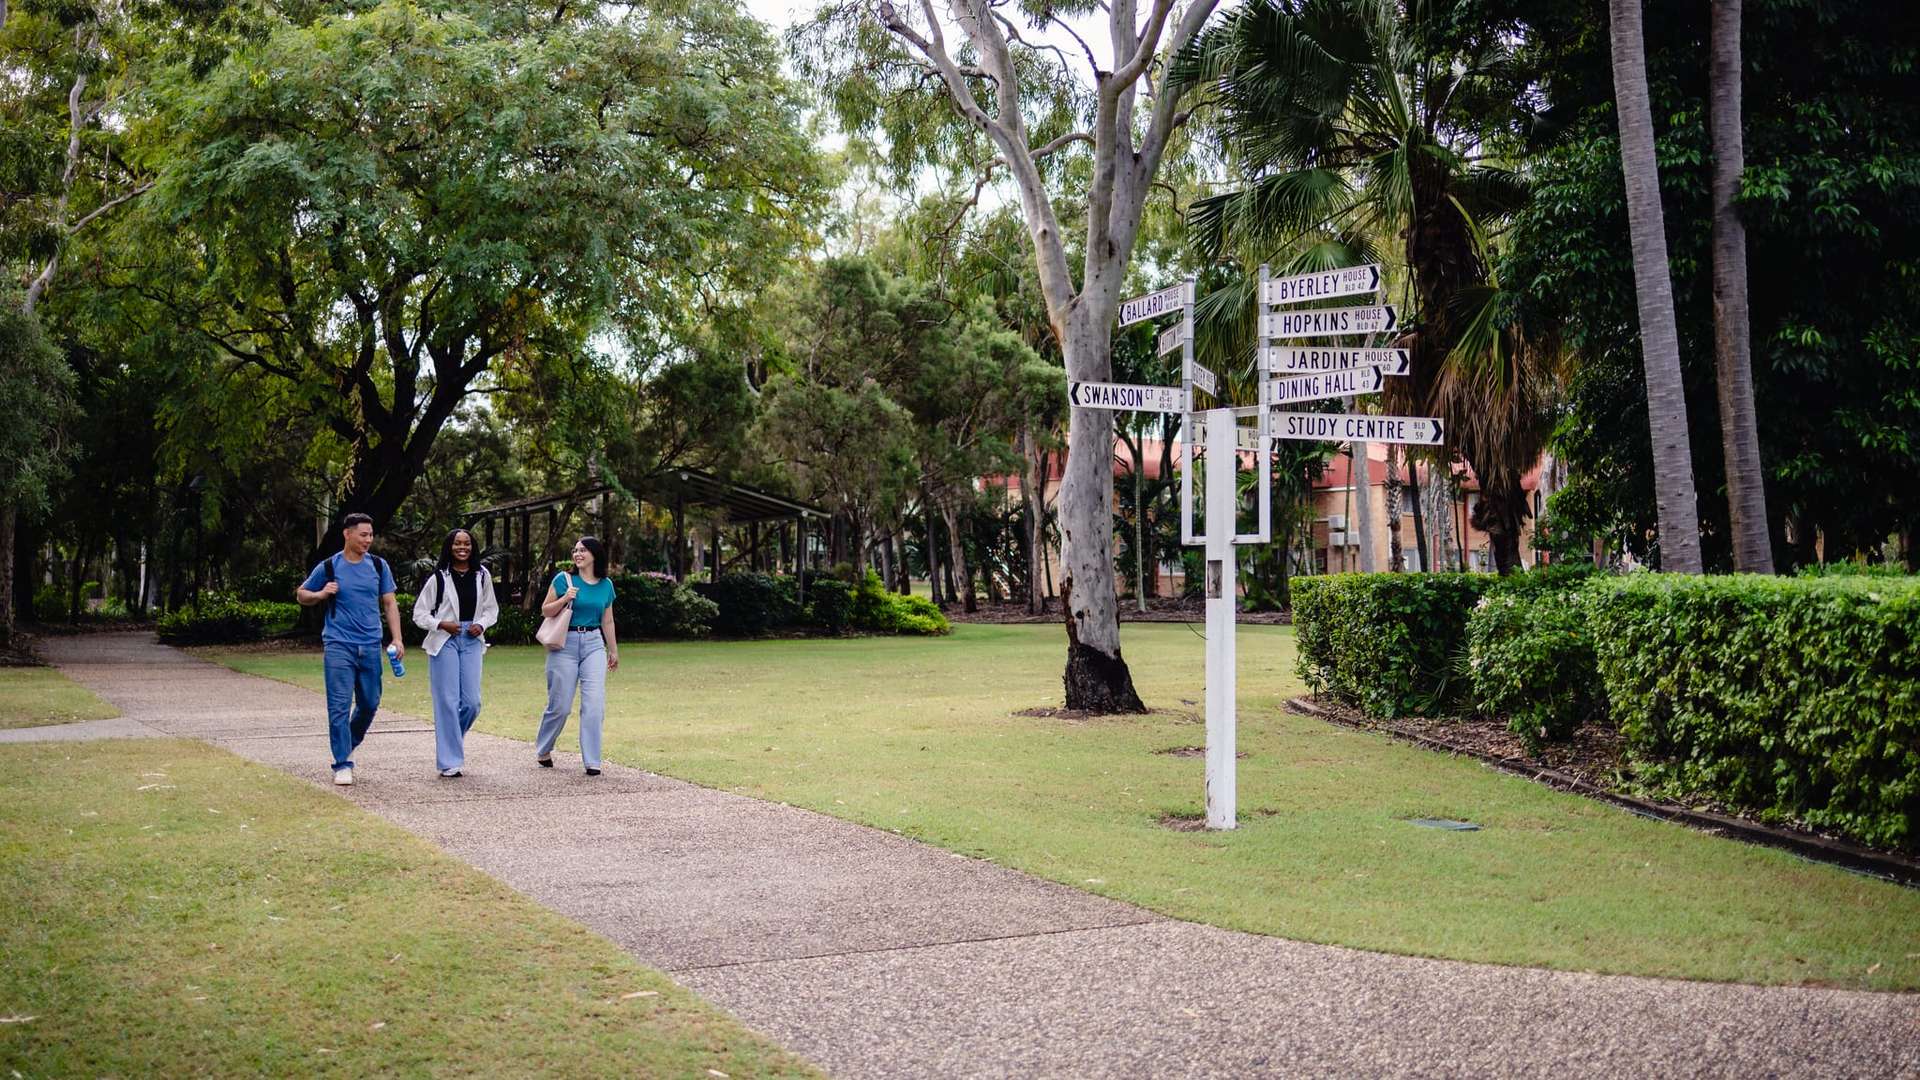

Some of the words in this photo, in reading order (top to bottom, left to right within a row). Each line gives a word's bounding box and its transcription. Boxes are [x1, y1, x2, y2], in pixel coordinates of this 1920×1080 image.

[1281, 274, 1339, 299] BYERLEY
[1343, 269, 1366, 281] HOUSE
[1126, 295, 1163, 321] BALLARD
[1283, 311, 1348, 334] HOPKINS
[1355, 309, 1381, 320] HOUSE
[1287, 351, 1360, 370] JARDINE
[1365, 351, 1393, 362] HOUSE
[1084, 385, 1143, 407] SWANSON
[1145, 389, 1154, 400] CT
[1279, 377, 1319, 400] DINING
[1325, 372, 1356, 394] HALL
[1288, 416, 1337, 436] STUDY
[1346, 419, 1405, 439] CENTRE
[1413, 421, 1426, 430] BLD
[1415, 431, 1424, 440] 59
